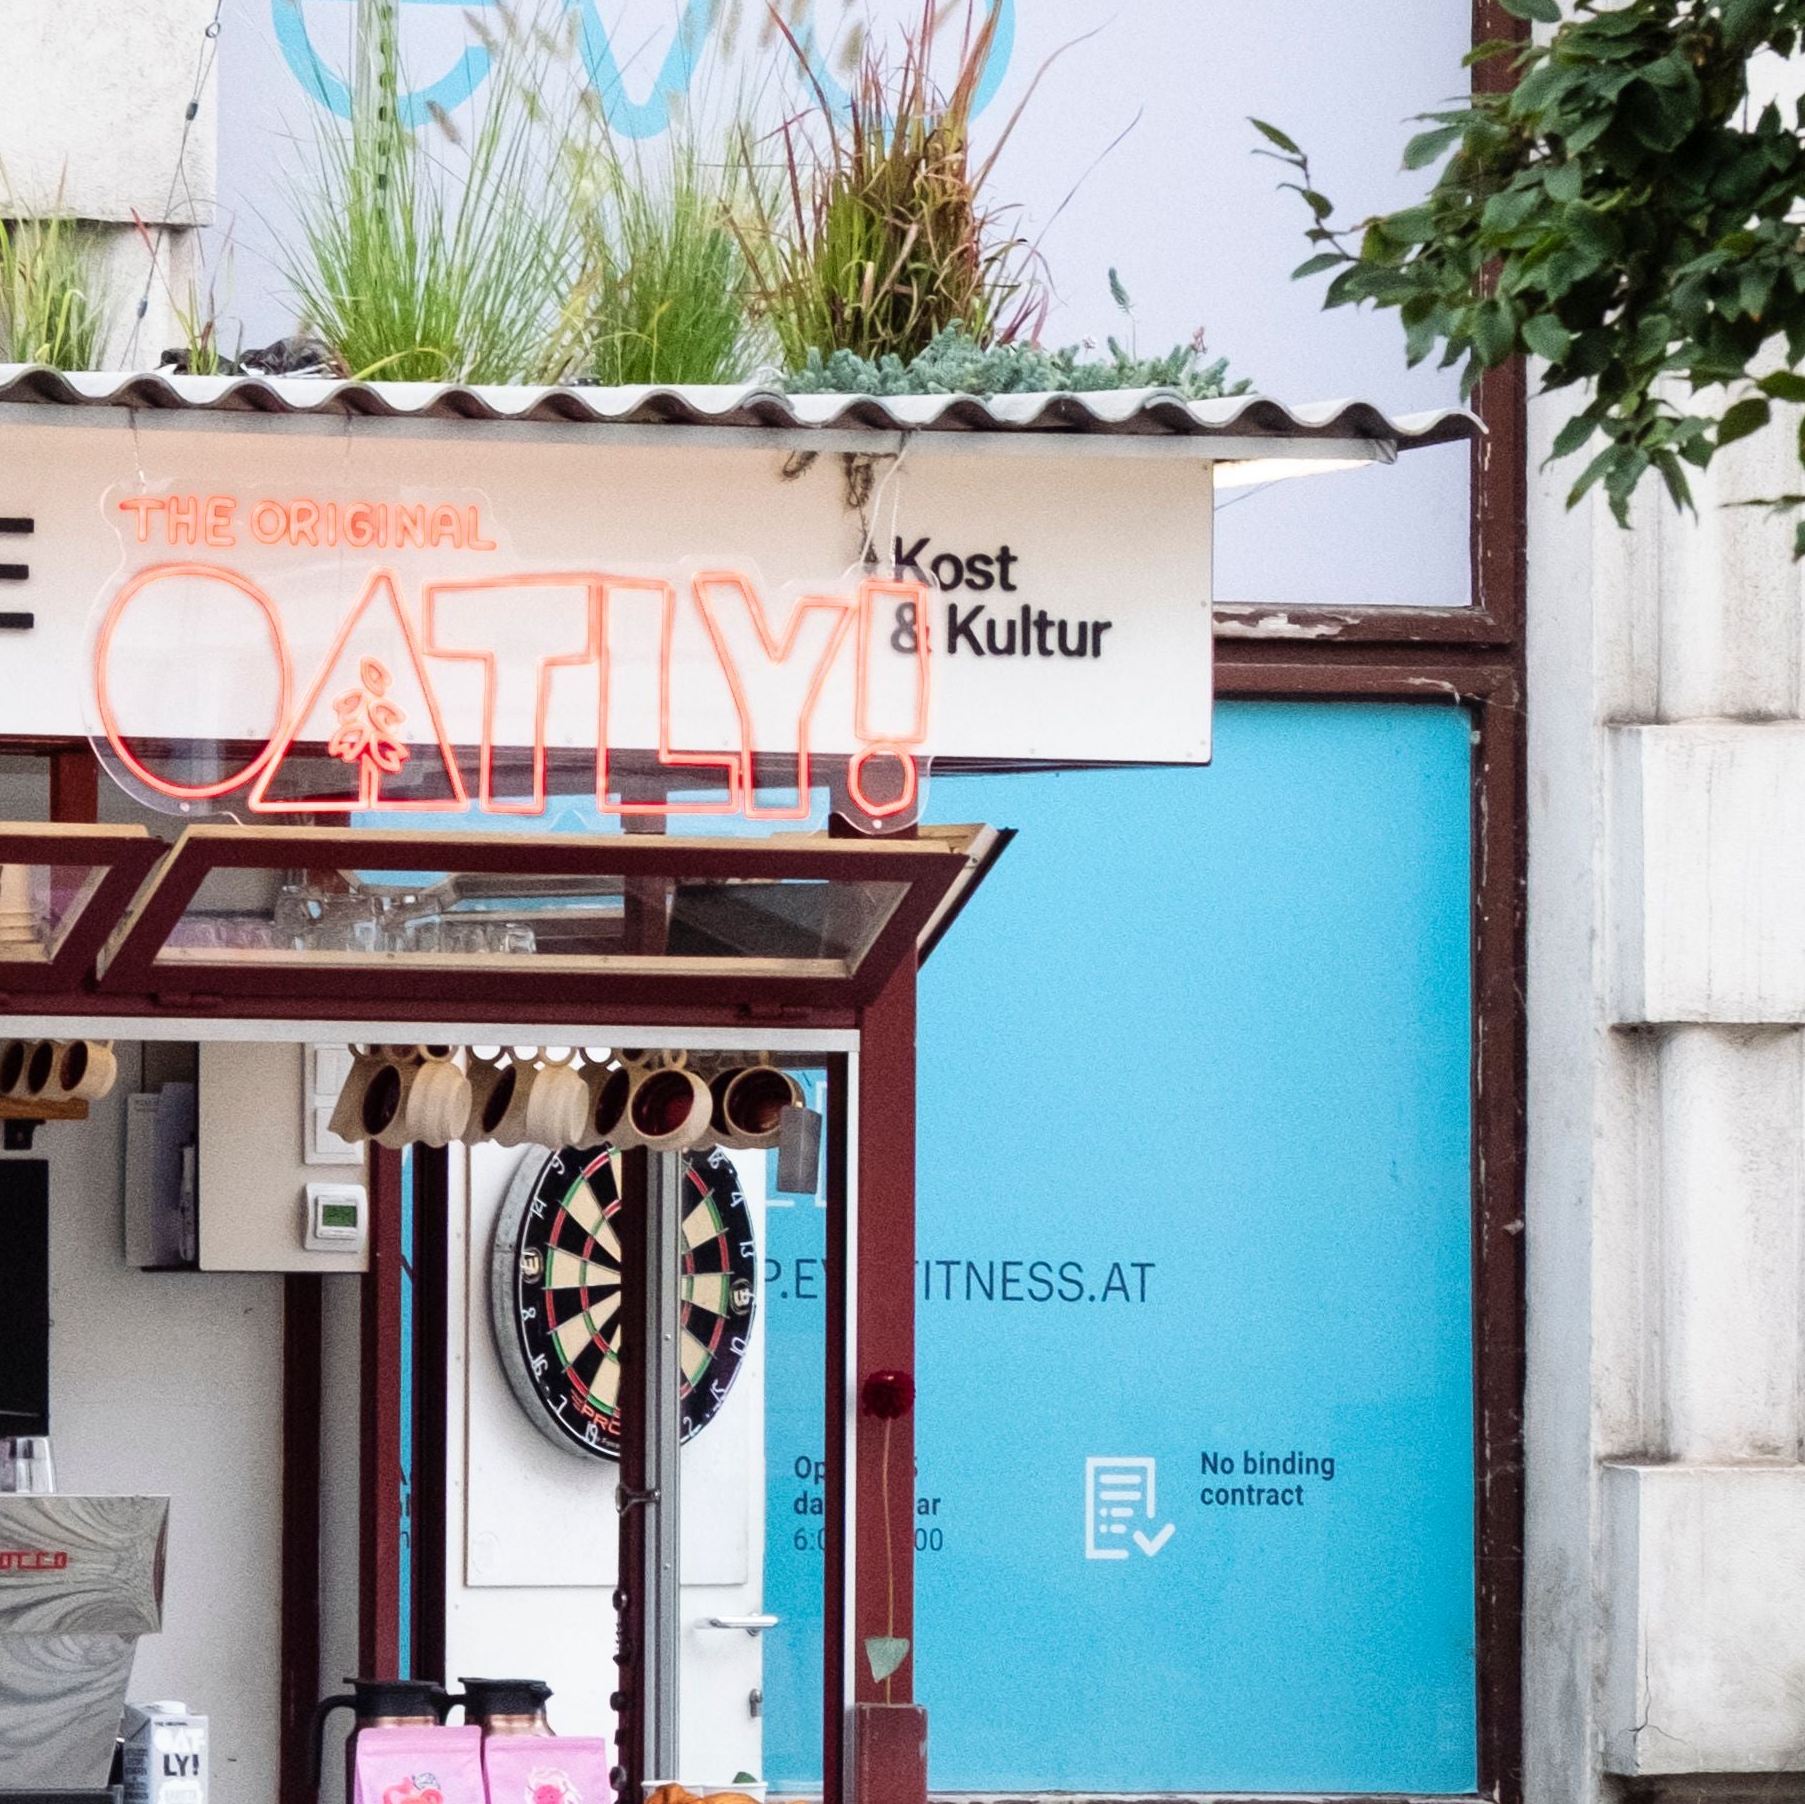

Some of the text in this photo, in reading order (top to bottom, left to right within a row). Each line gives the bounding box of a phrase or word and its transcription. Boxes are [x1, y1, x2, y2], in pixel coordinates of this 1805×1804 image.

[118, 496, 499, 552] THE ORIGINAL
[892, 535, 1017, 594] Kost
[889, 601, 1114, 659] & Kultur
[95, 562, 931, 820] OATLY!
[1201, 1451, 1336, 1480] No binding
[1200, 1484, 1305, 1507] contract
[163, 1754, 200, 1777] LY!
